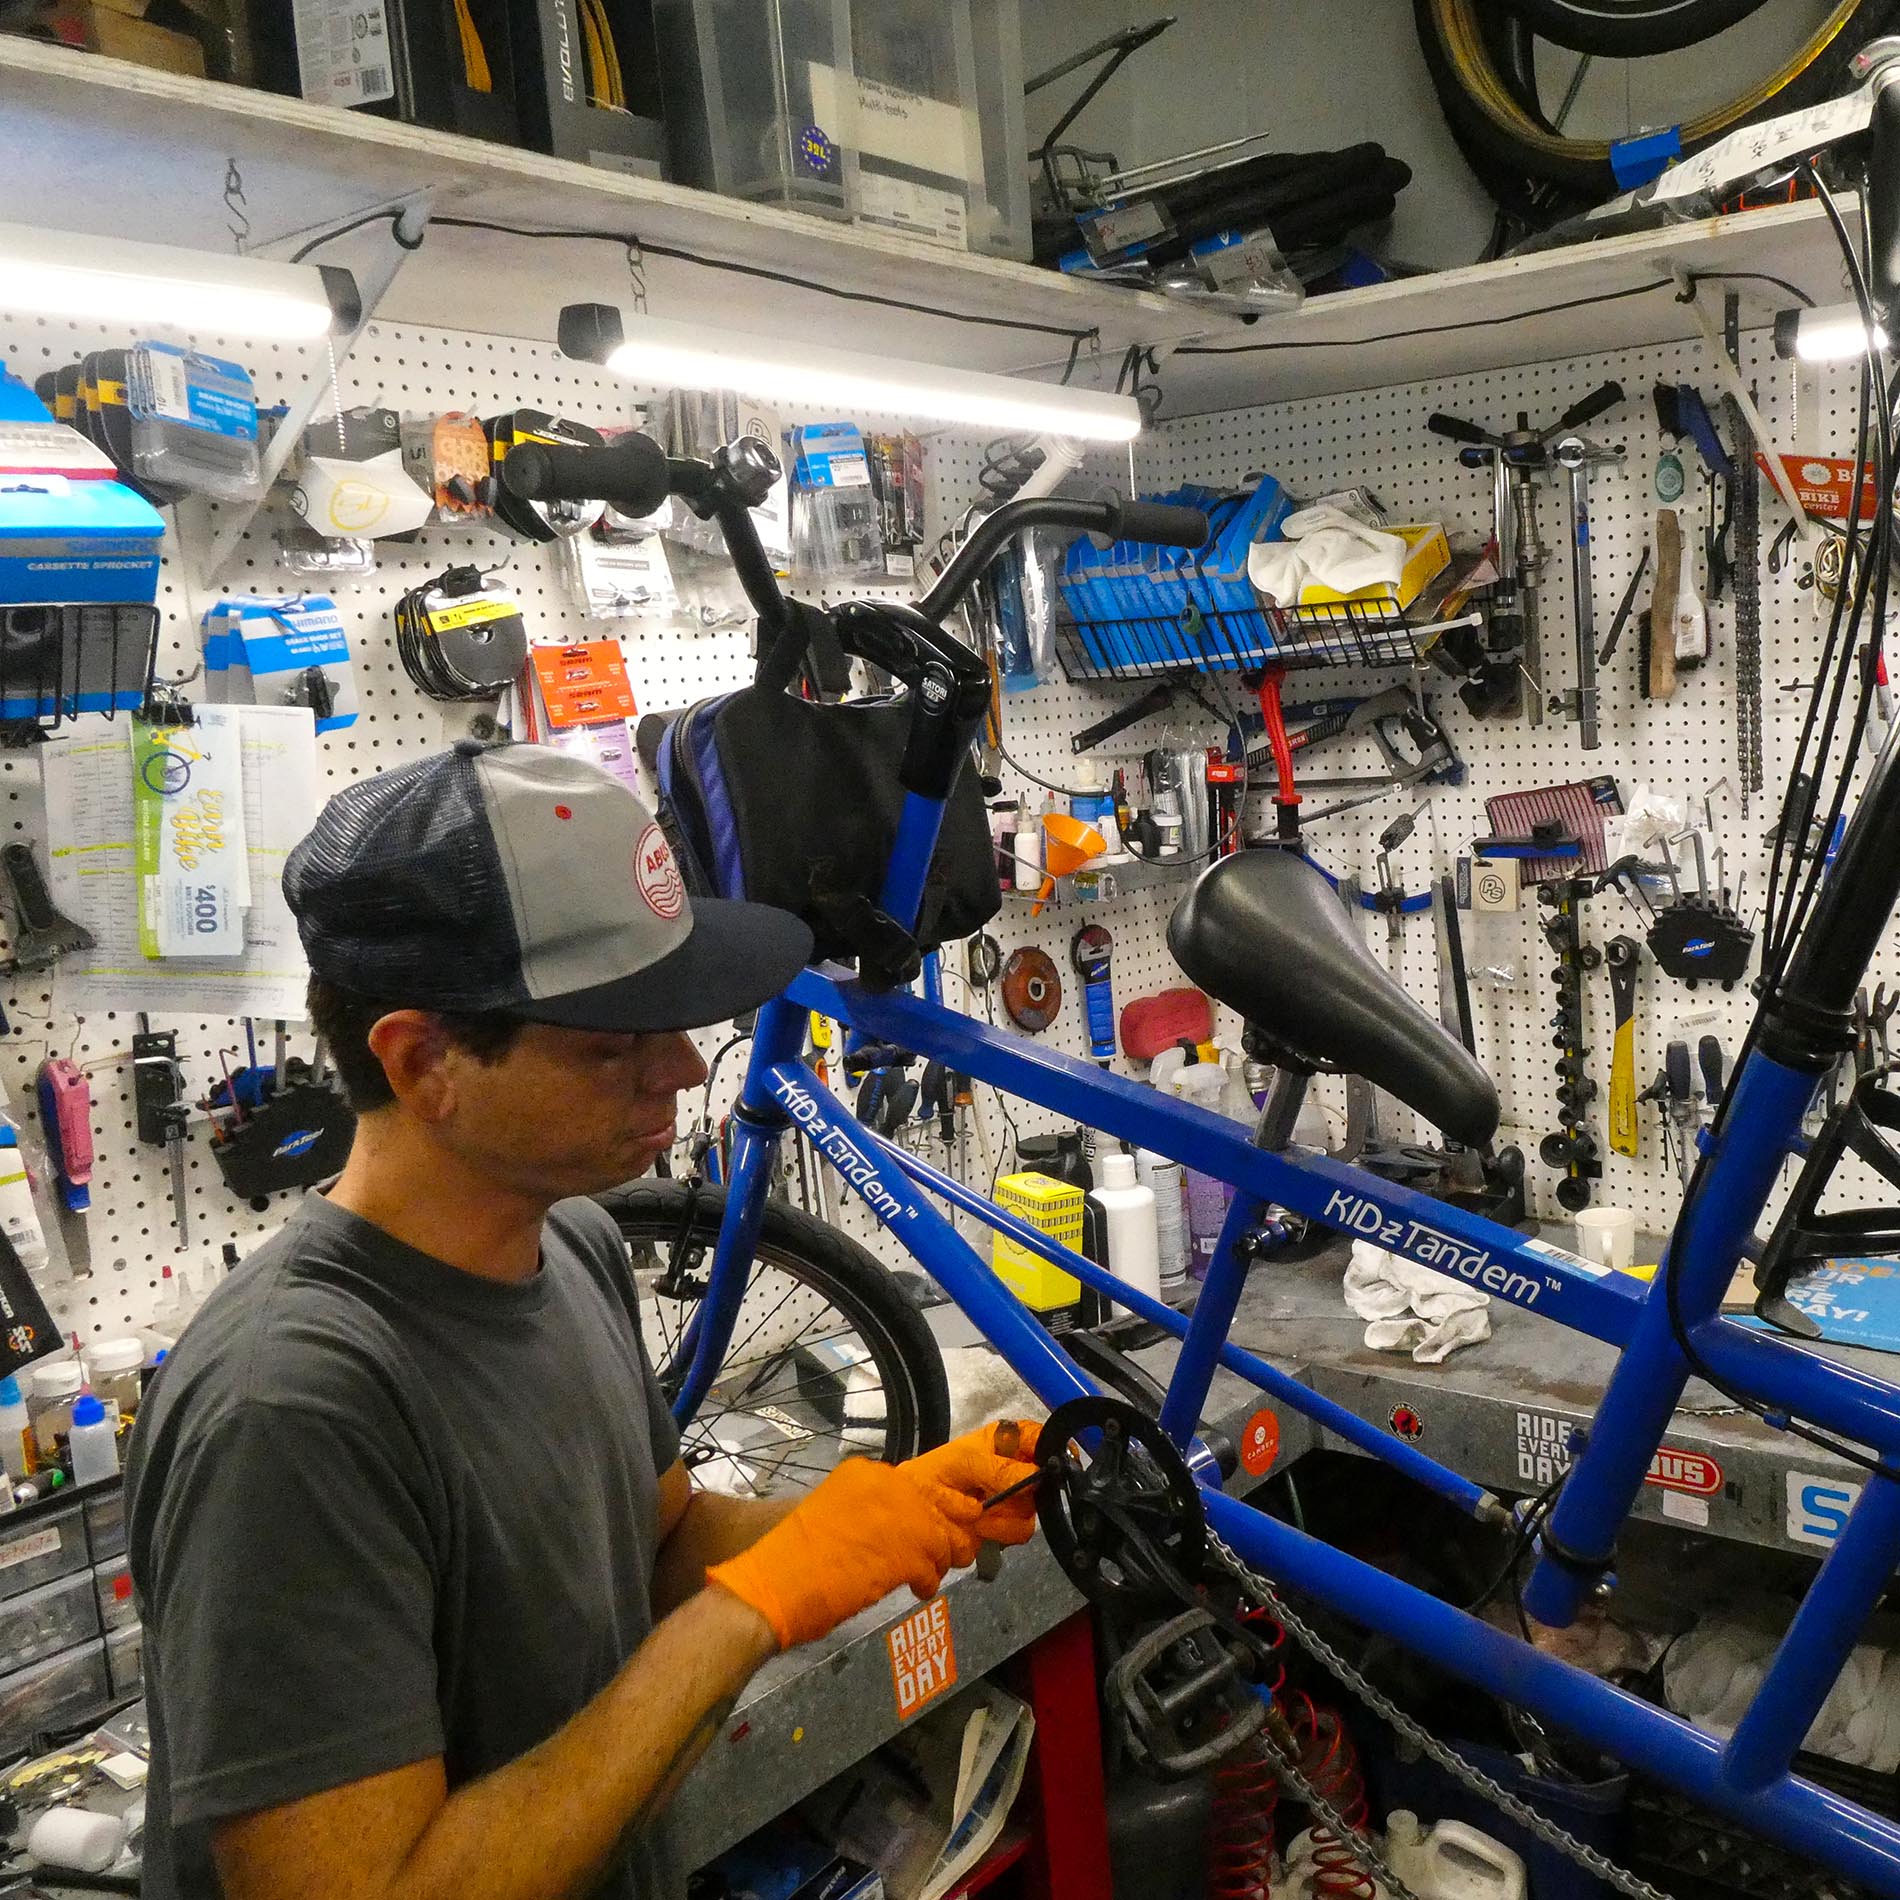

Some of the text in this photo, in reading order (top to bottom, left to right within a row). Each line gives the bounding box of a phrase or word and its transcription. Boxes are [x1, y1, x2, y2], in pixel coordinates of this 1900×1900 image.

[1800, 491, 1840, 503] BIKE
[1803, 502, 1838, 511] center
[92, 560, 153, 570] SPROCKET
[291, 614, 338, 629] HIMANO
[921, 677, 948, 698] SATORI
[195, 884, 218, 934] $400
[1516, 1412, 1572, 1444] RIDE
[1518, 1436, 1570, 1461] EVERY
[1647, 1453, 1704, 1484] US
[890, 1599, 946, 1659] RIDE
[894, 1626, 946, 1678] EVERY
[898, 1645, 948, 1710] DAY
